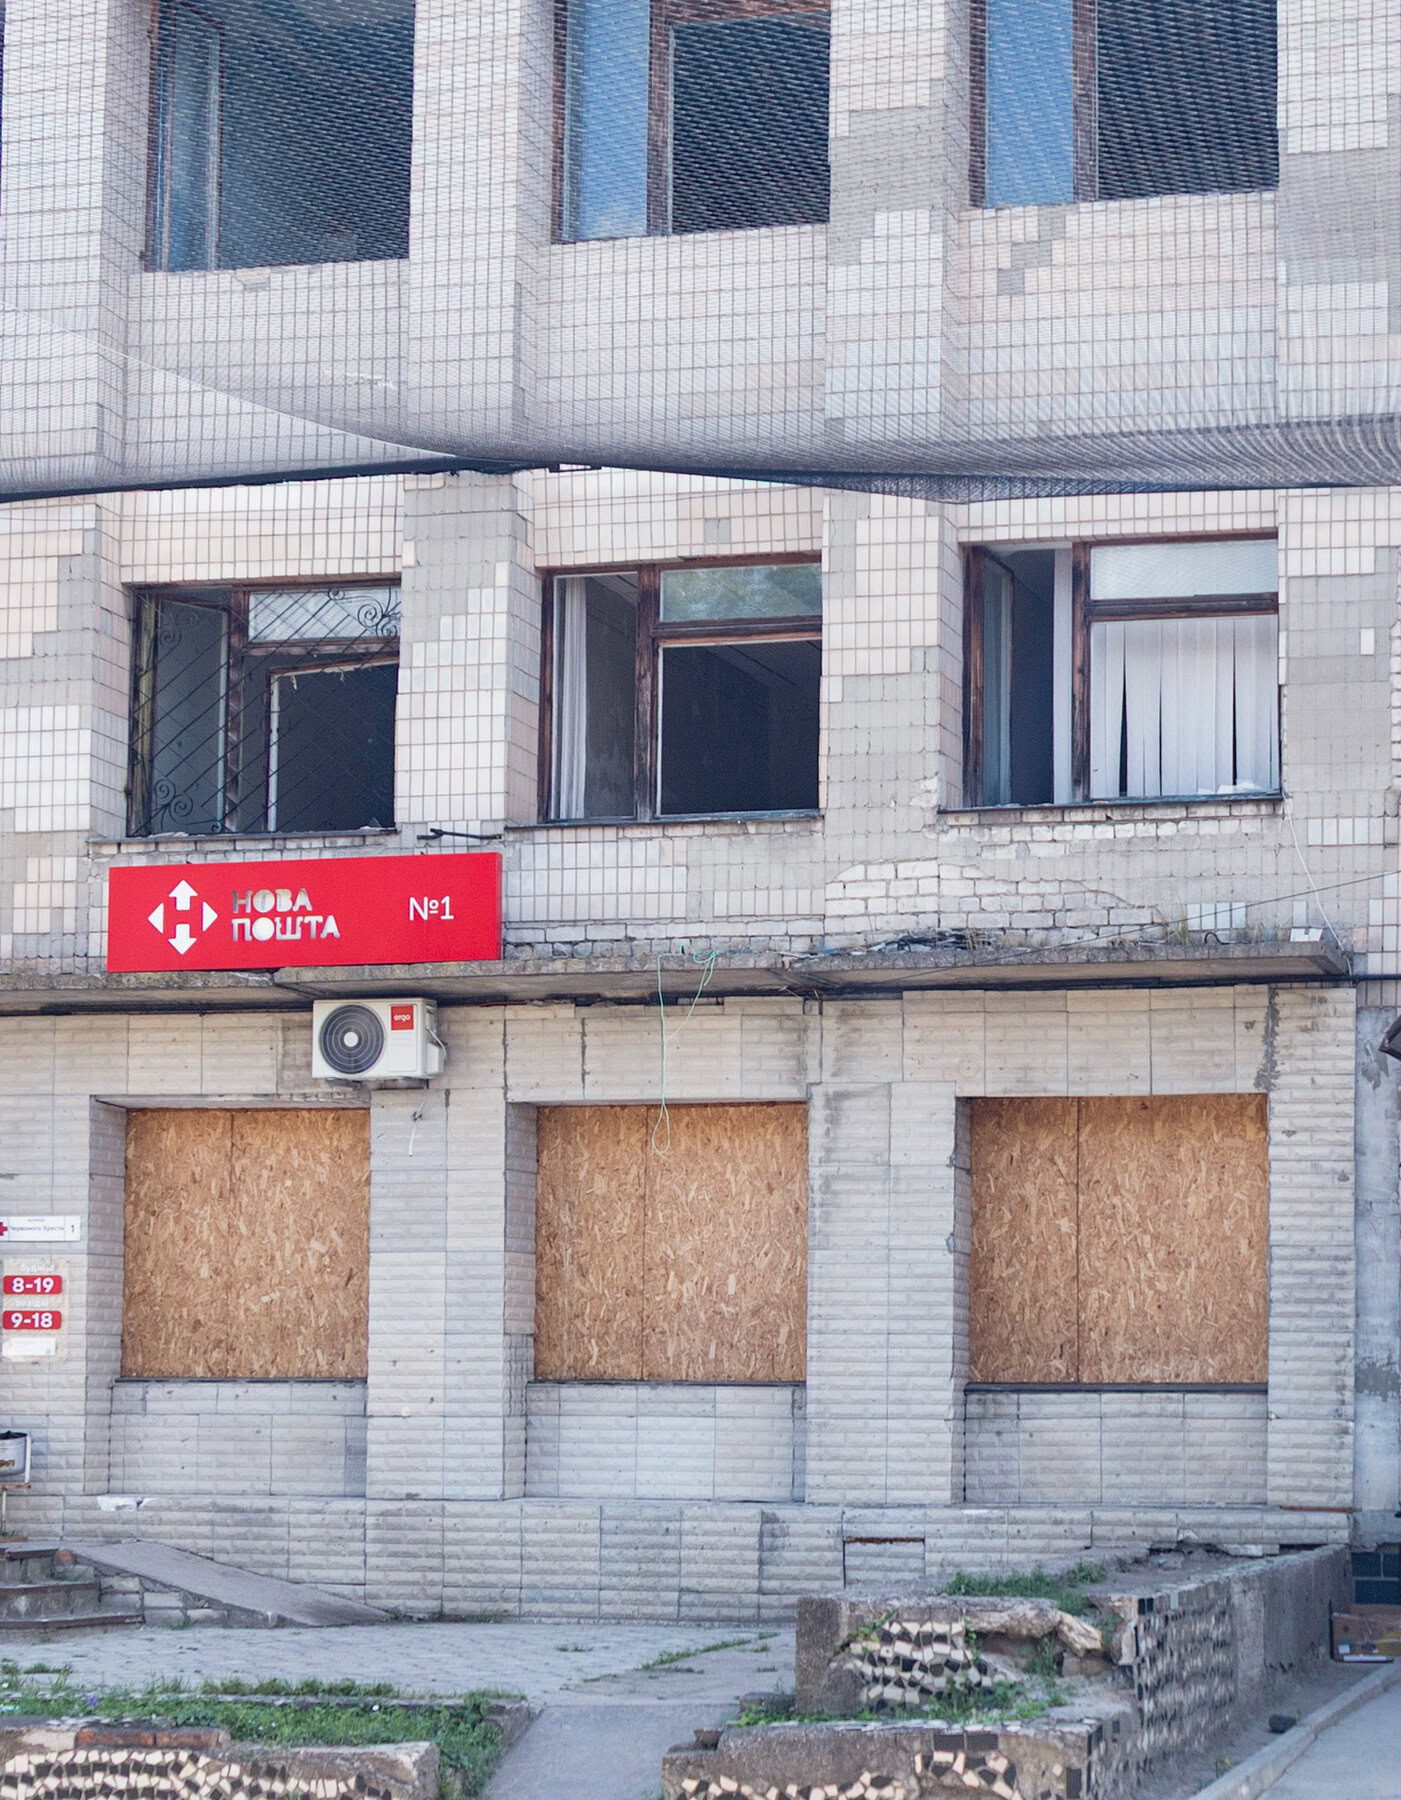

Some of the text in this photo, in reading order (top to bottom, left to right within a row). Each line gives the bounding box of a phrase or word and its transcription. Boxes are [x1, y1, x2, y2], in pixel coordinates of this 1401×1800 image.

[231, 887, 313, 914] НОВА
[408, 894, 455, 921] №1
[231, 914, 341, 941] ПОШТА
[12, 1277, 54, 1293] 8-19
[11, 1313, 53, 1328] 9-18
